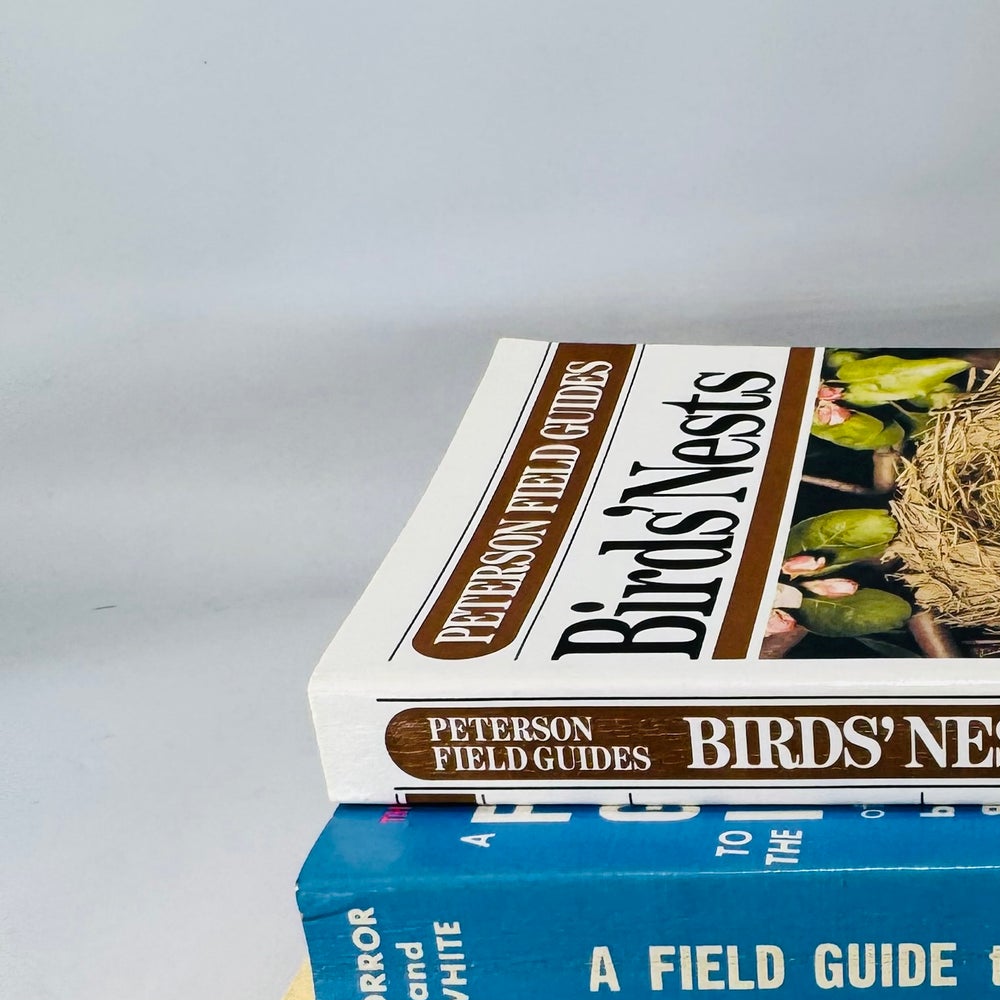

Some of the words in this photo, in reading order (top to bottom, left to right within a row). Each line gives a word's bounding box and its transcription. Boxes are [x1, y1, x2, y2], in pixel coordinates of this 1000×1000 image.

[539, 360, 613, 440] GUIDES
[619, 370, 776, 503] Nests
[505, 444, 581, 514] FIELD
[433, 519, 552, 645] PETERSON
[551, 505, 740, 661] Birds'
[427, 716, 593, 743] PETERSON
[682, 715, 895, 771] BIRDS'
[434, 747, 528, 772] FIELD
[533, 746, 652, 772] GUIDES
[460, 833, 496, 848] A
[715, 830, 753, 857] TO
[765, 829, 803, 866] THE
[589, 946, 621, 993] A
[649, 944, 786, 992] FIELD
[814, 942, 958, 989] GUIDE
